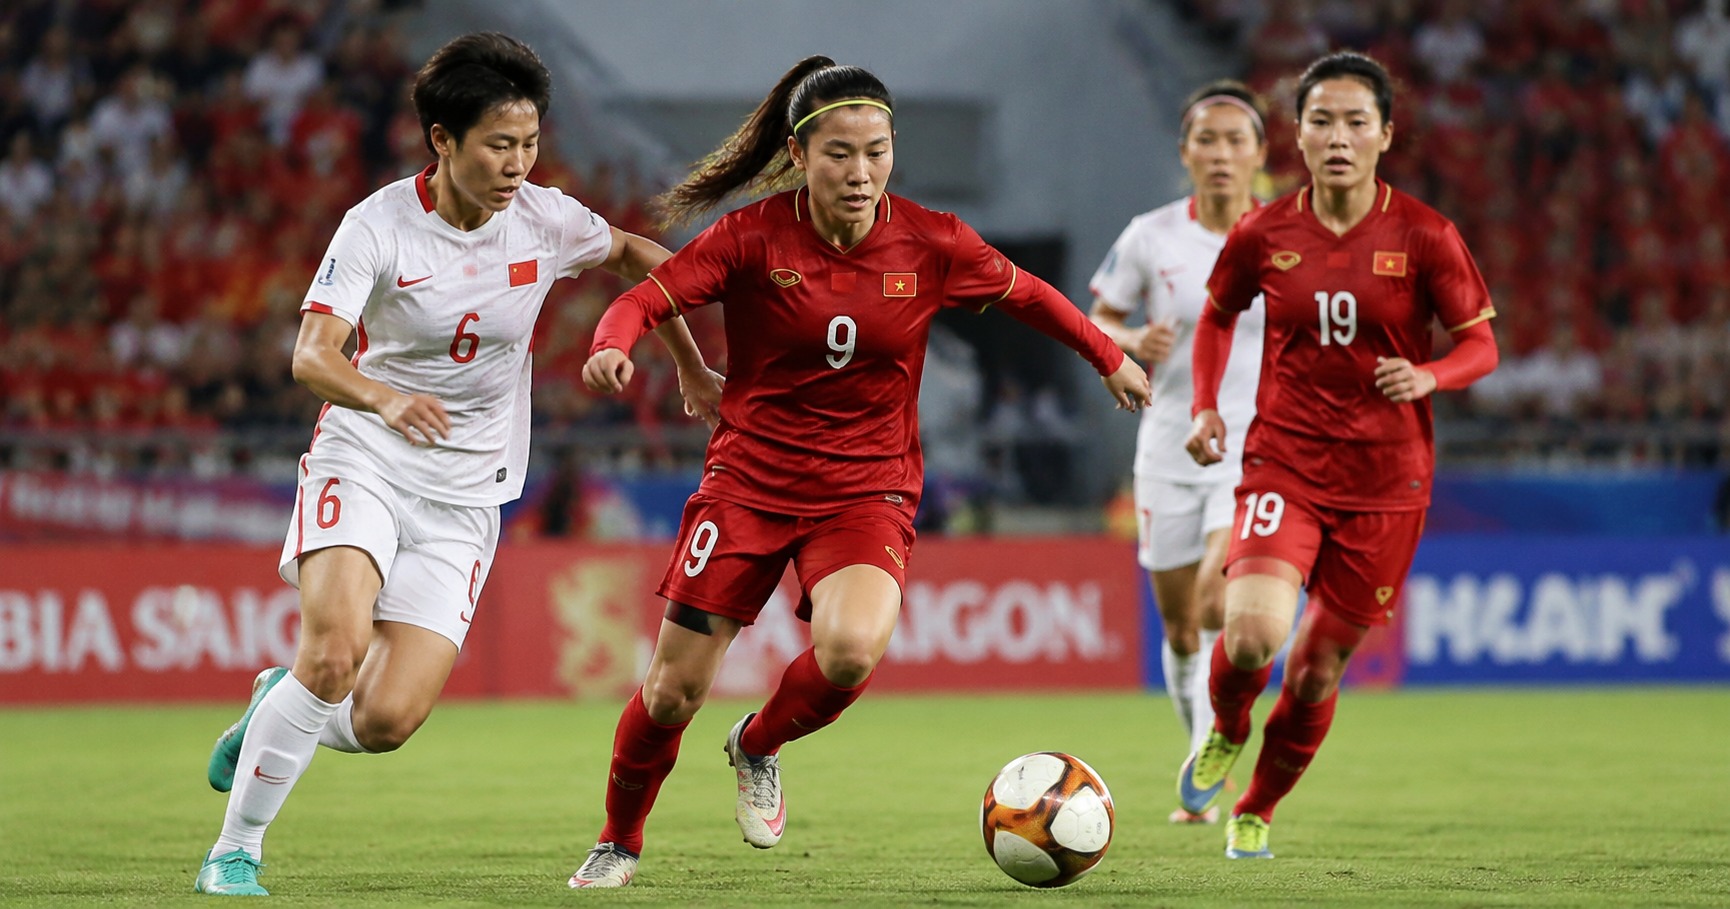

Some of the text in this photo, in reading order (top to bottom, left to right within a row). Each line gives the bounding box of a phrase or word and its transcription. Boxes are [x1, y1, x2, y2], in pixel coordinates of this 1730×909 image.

[449, 312, 480, 364] 6
[826, 315, 857, 369] 9
[1314, 290, 1357, 346] 19
[316, 477, 341, 529] 6
[1240, 491, 1285, 540] 19
[684, 520, 719, 577] 9
[0, 586, 301, 671] BIA SAIG
